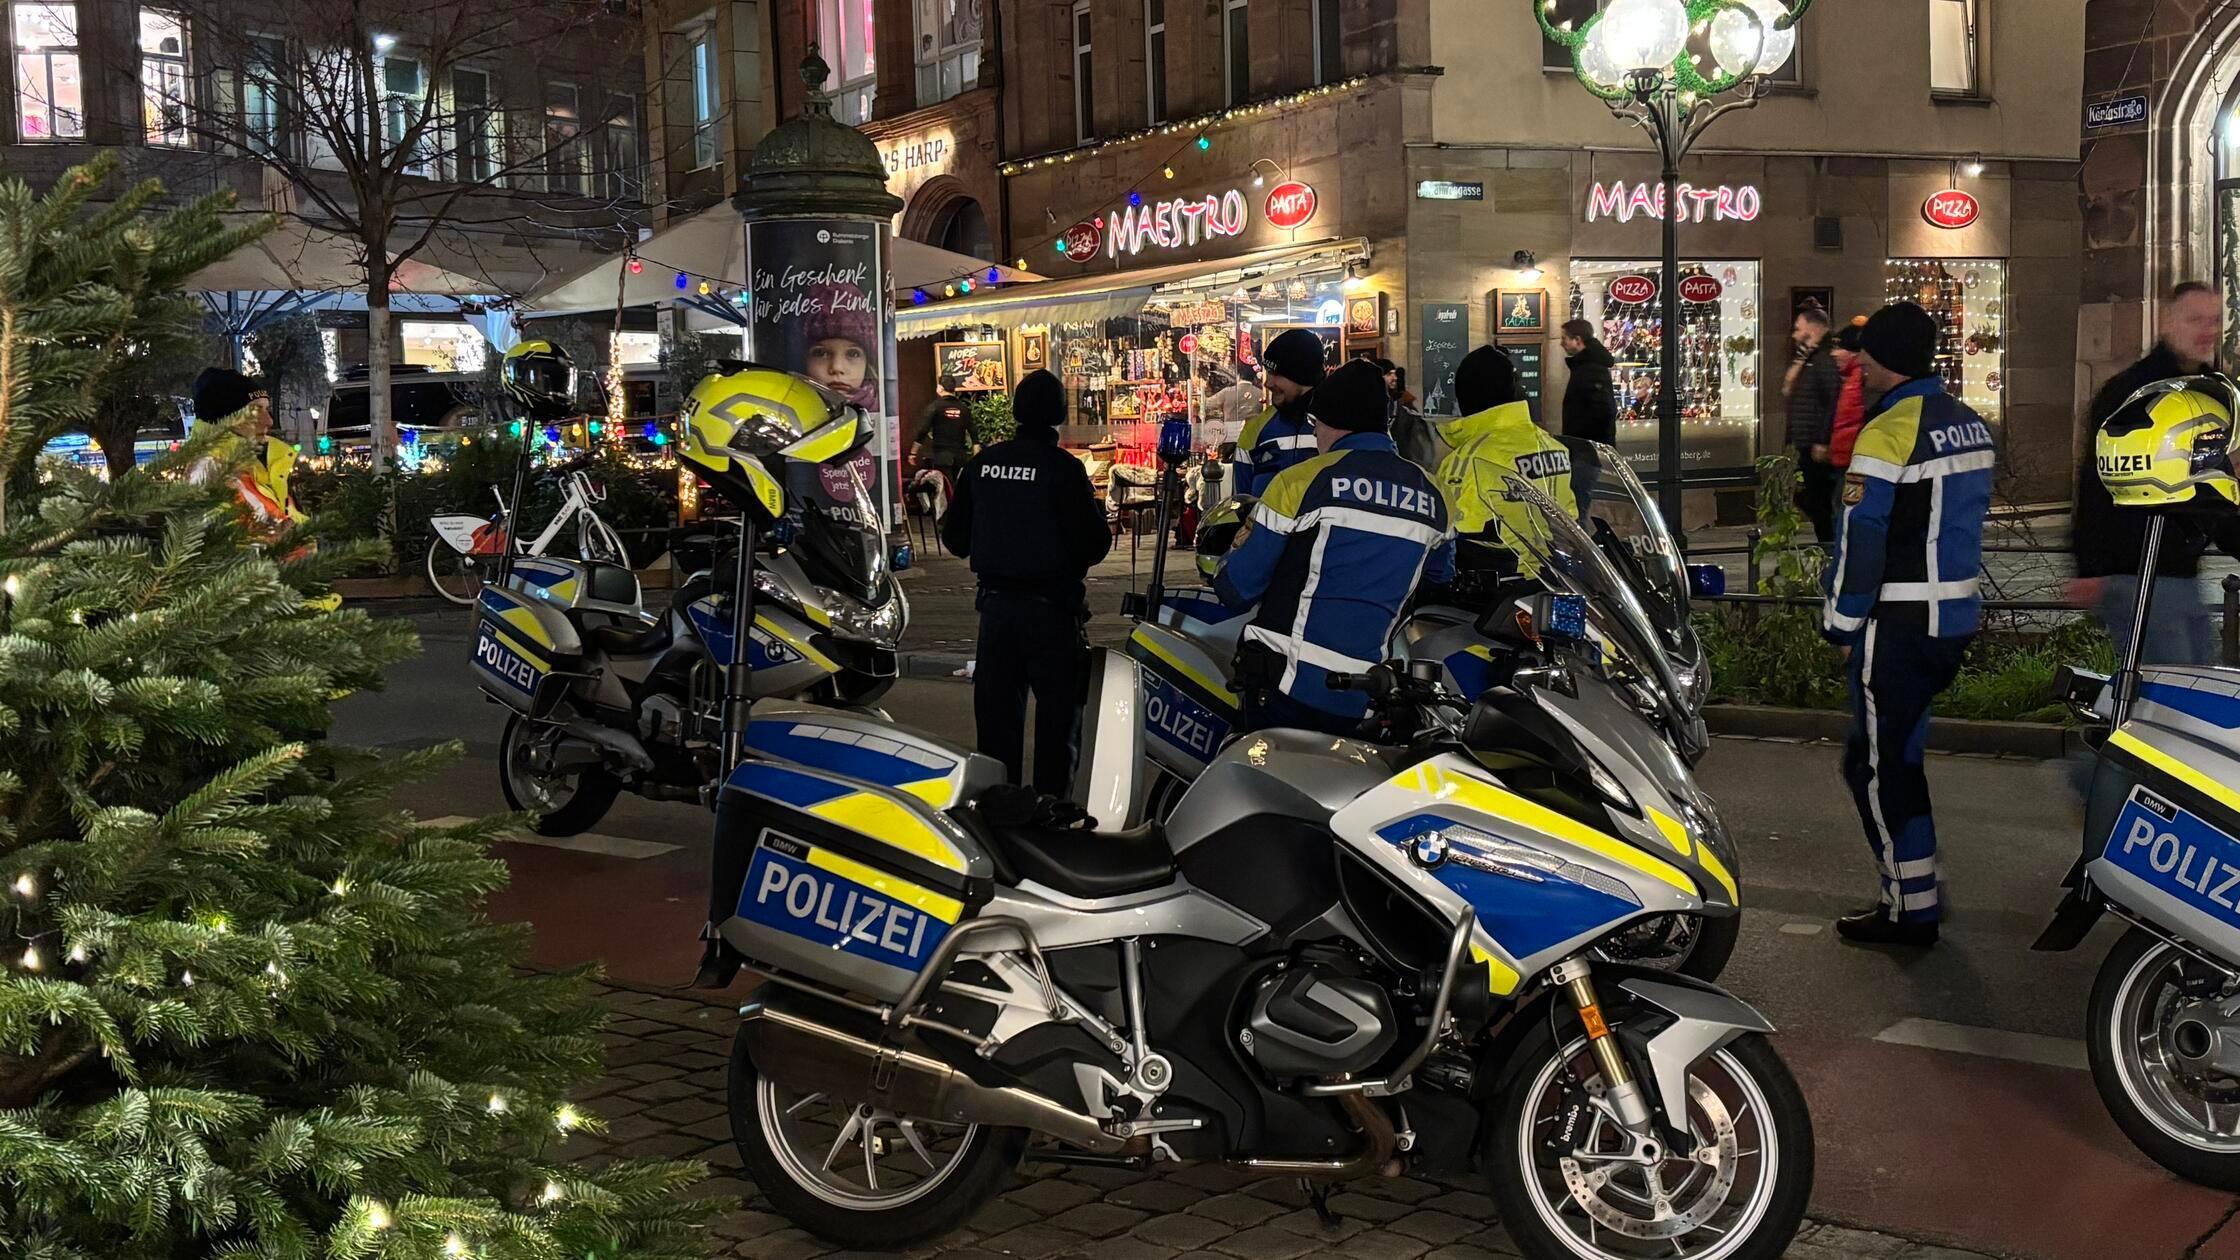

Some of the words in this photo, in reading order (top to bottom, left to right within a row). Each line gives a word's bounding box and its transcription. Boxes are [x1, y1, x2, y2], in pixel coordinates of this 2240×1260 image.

[1270, 191, 1306, 216] PASTA
[1933, 198, 1972, 217] PIZZA
[1108, 188, 1245, 259] MAESTRO
[754, 268, 774, 292] Ein
[780, 262, 867, 292] Geschenk
[1615, 283, 1649, 297] PIZZA
[1685, 282, 1718, 295] PASTA
[754, 297, 773, 323] für
[772, 293, 823, 323] jedes
[830, 290, 876, 314] Kind.
[1505, 316, 1537, 327] SALATE
[948, 347, 978, 360] MORE
[980, 464, 1036, 481] POLIZEI
[2098, 454, 2152, 472] OLIZEI
[1331, 477, 1436, 519] POLIZEI
[477, 635, 535, 689] POLIZEI
[2143, 796, 2167, 814] BMW
[772, 838, 798, 854] BMW
[2123, 816, 2240, 914] POLIZ
[757, 861, 929, 958] POLIZEI
[1560, 1104, 1580, 1143] brembo
